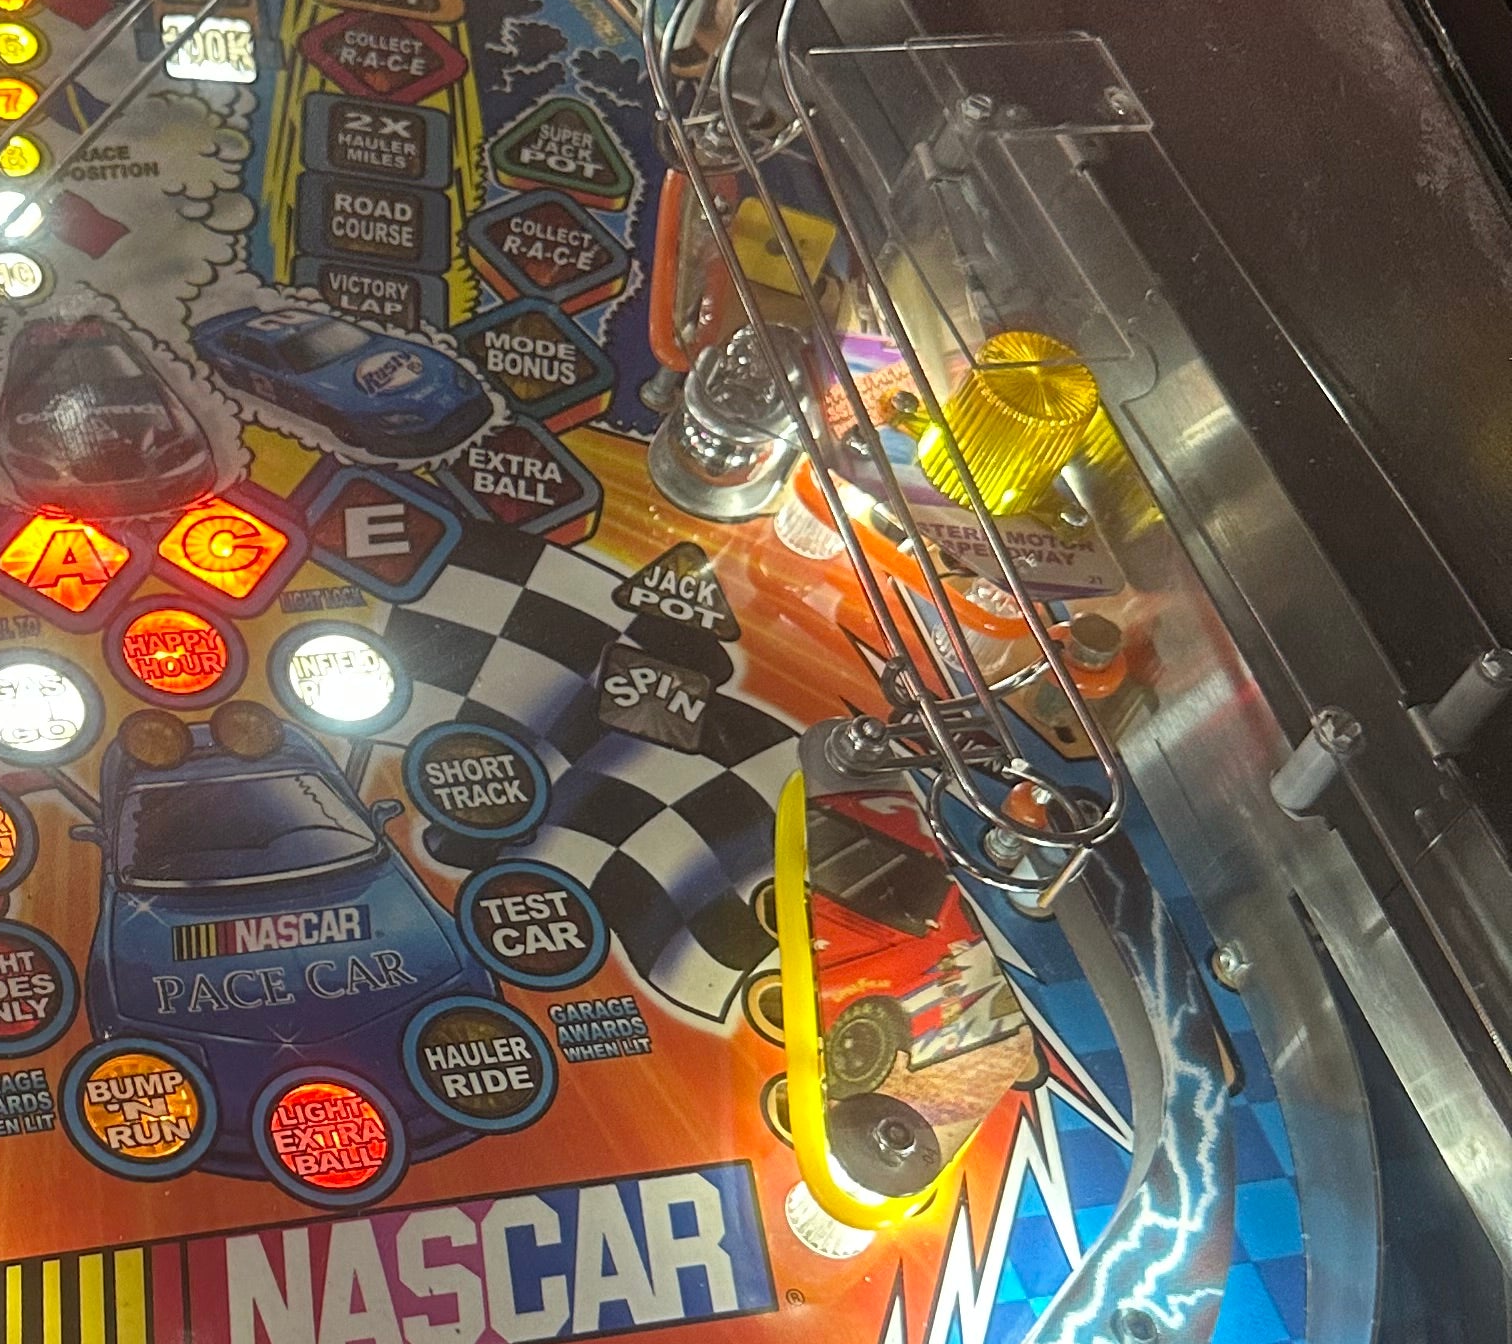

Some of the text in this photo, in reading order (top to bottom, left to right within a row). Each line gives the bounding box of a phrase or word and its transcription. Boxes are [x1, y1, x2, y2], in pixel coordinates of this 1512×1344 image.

[344, 30, 423, 55] COLLECT
[339, 49, 427, 76] R-A-C-E
[337, 132, 417, 156] HAULER
[531, 139, 593, 162] JACK
[539, 123, 594, 148] SUPER
[346, 148, 407, 169] MILES
[520, 150, 607, 180] POT
[334, 193, 413, 222] ROAD
[331, 218, 414, 248] COURSE
[510, 217, 595, 250] COLLECT
[503, 234, 595, 272] R-A-C-E
[329, 272, 410, 302] VICTORY
[340, 295, 404, 318] LAP
[484, 331, 577, 362] MODE
[488, 354, 577, 385] BONUS
[468, 447, 563, 484] EXTRA
[472, 471, 556, 506] BALL
[26, 528, 110, 588] A
[181, 515, 265, 573] C
[343, 502, 411, 559] E
[940, 541, 1075, 566] SPEDWAY
[643, 564, 719, 606] JACK
[628, 588, 726, 631] POT
[123, 630, 220, 658] HAPPY
[136, 653, 223, 680] HOUR
[291, 649, 381, 680] INFIELD
[604, 665, 705, 724] SPIN
[424, 754, 516, 788] SHORT
[433, 779, 529, 810] TRACK
[480, 891, 571, 926] TEST
[234, 907, 362, 954] NASCAR
[491, 919, 587, 958] CAR
[152, 950, 419, 1015] PACE CAR
[548, 996, 638, 1023] GARAGE
[557, 1016, 649, 1045] AWARDS
[424, 1035, 533, 1072] HAULER
[562, 1036, 653, 1064] WHEN LIT
[87, 1071, 185, 1104] BUMP
[441, 1065, 535, 1099] RIDE
[25, 1113, 56, 1136] LIT
[276, 1099, 363, 1129] LIGHT
[107, 1117, 192, 1152] RUN
[273, 1119, 387, 1155] EXTRA
[292, 1146, 382, 1178] BALL
